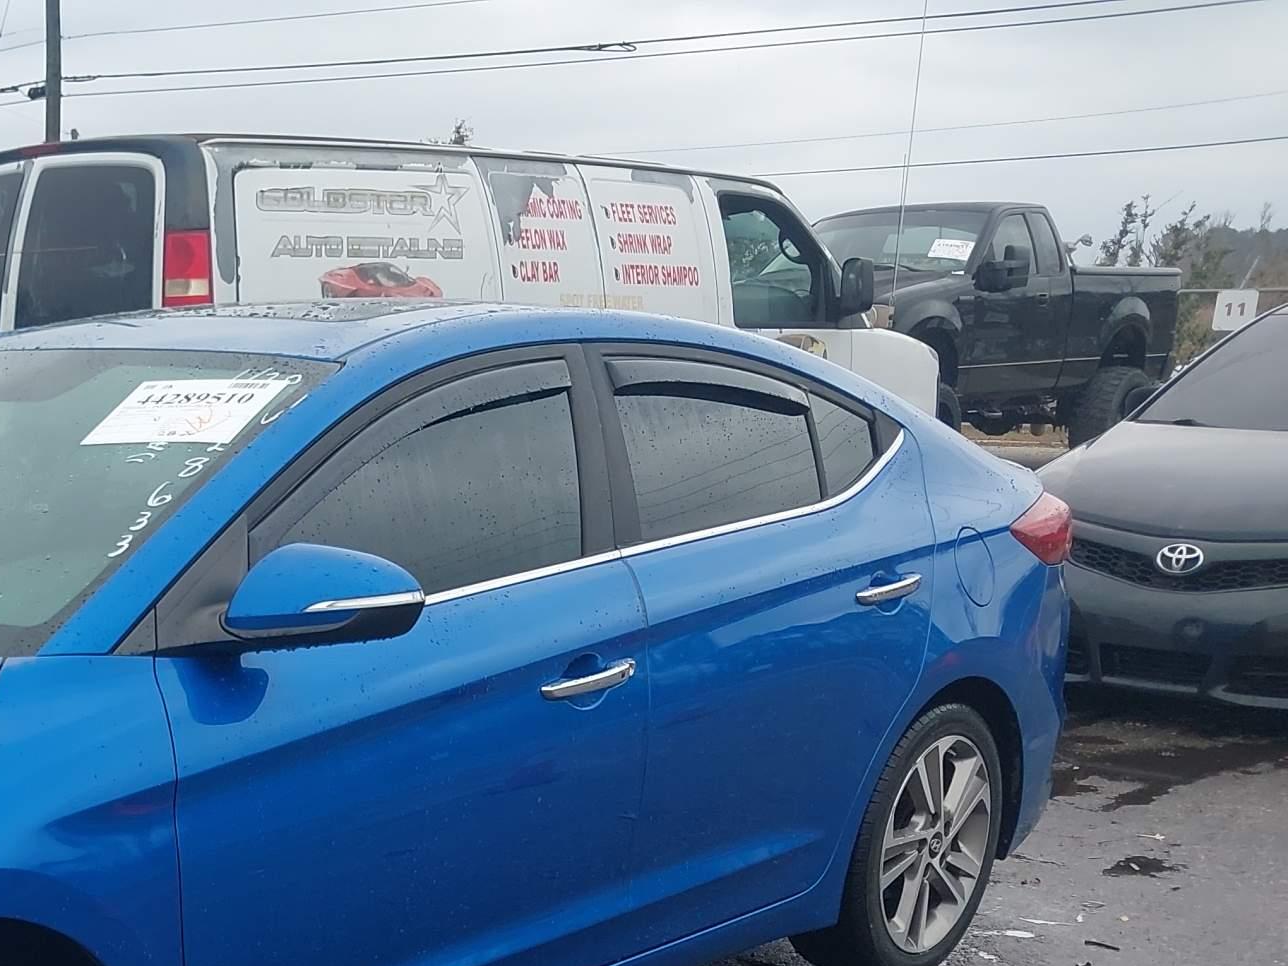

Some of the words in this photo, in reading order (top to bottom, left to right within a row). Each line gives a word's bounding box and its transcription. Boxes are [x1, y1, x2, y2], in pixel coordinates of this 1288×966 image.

[547, 198, 582, 220] COATING
[610, 202, 637, 223] FLEET
[637, 204, 677, 225] SERVICES
[271, 235, 343, 258] AUTO
[547, 229, 568, 251] WAX
[617, 233, 649, 254] SHRINK
[649, 234, 672, 255] WRAP
[519, 261, 539, 282] CLAY
[541, 261, 560, 283] BAR
[621, 264, 660, 285] INTERIOR
[661, 265, 700, 286] SHAMPOO
[1224, 302, 1246, 317] 11
[137, 391, 255, 406] 44289510
